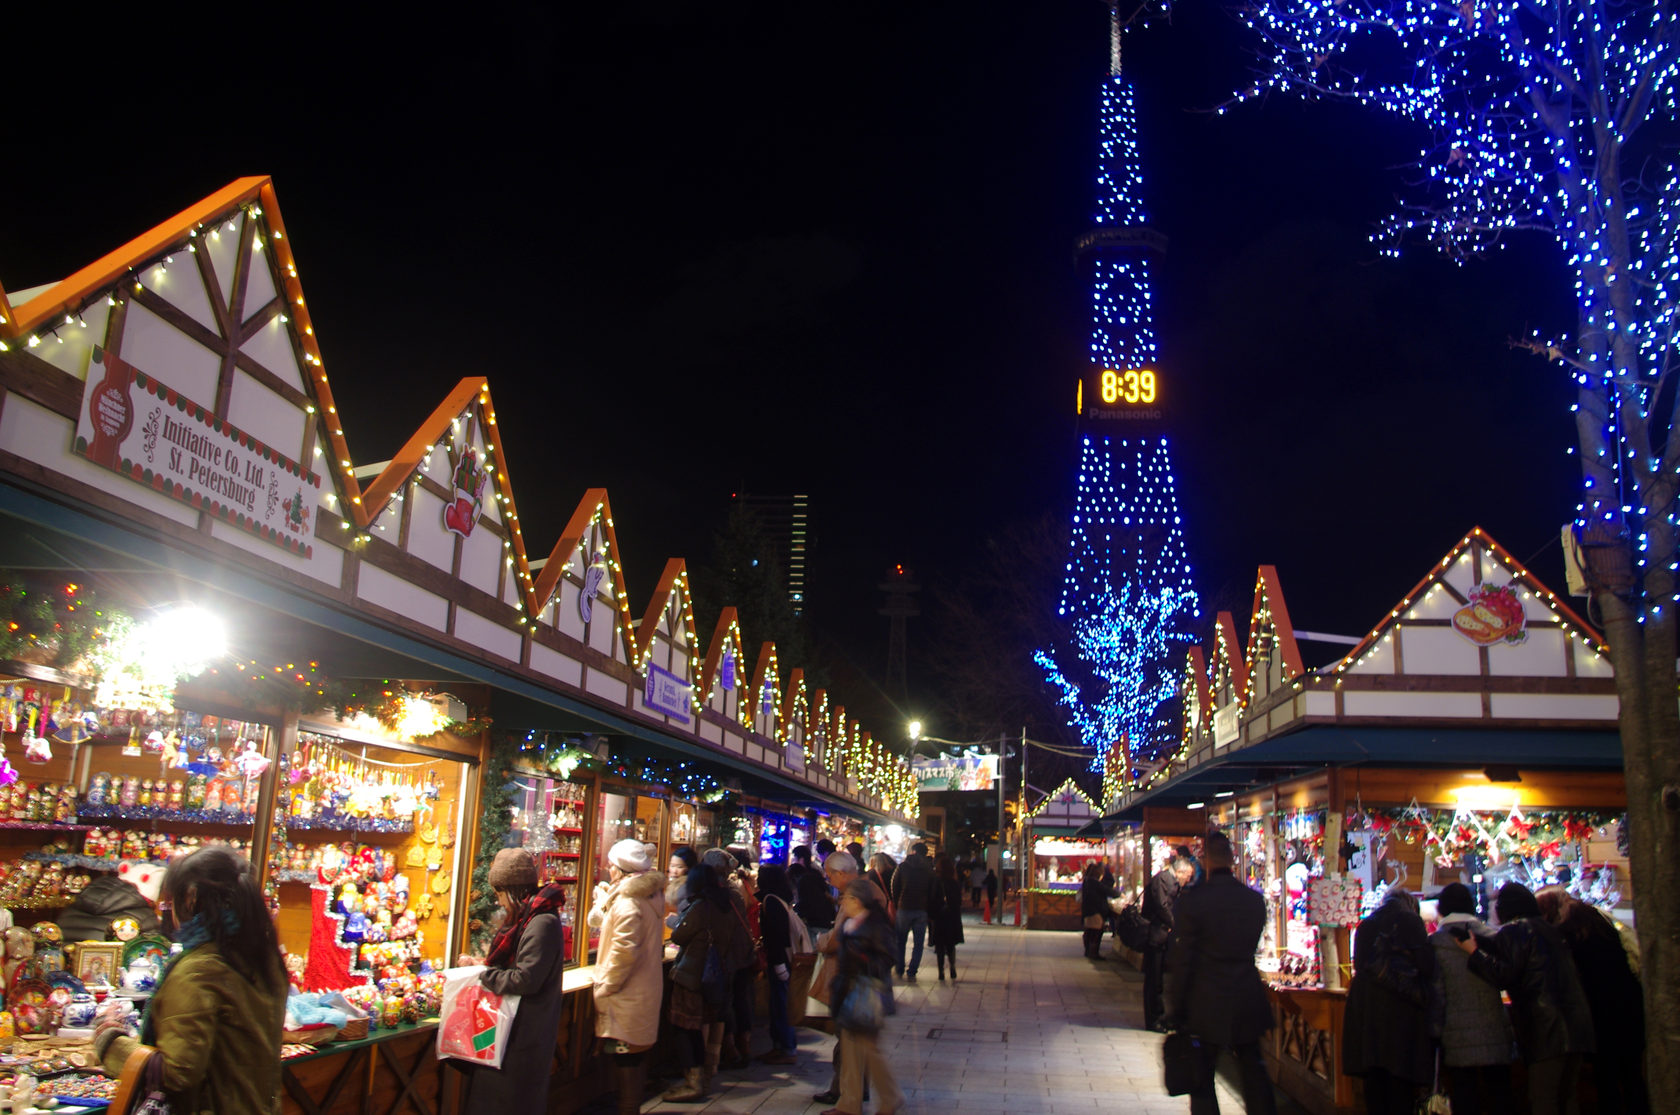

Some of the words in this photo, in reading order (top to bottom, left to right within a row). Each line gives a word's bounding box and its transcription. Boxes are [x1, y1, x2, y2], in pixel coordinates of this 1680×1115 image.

[1101, 370, 1156, 403] 8:39
[1089, 407, 1162, 420] Panasonic
[162, 414, 222, 466] Initiative
[224, 449, 241, 478] Co.
[244, 460, 265, 490] Ltd.
[168, 446, 184, 476] St.
[188, 456, 256, 512] Petersburg
